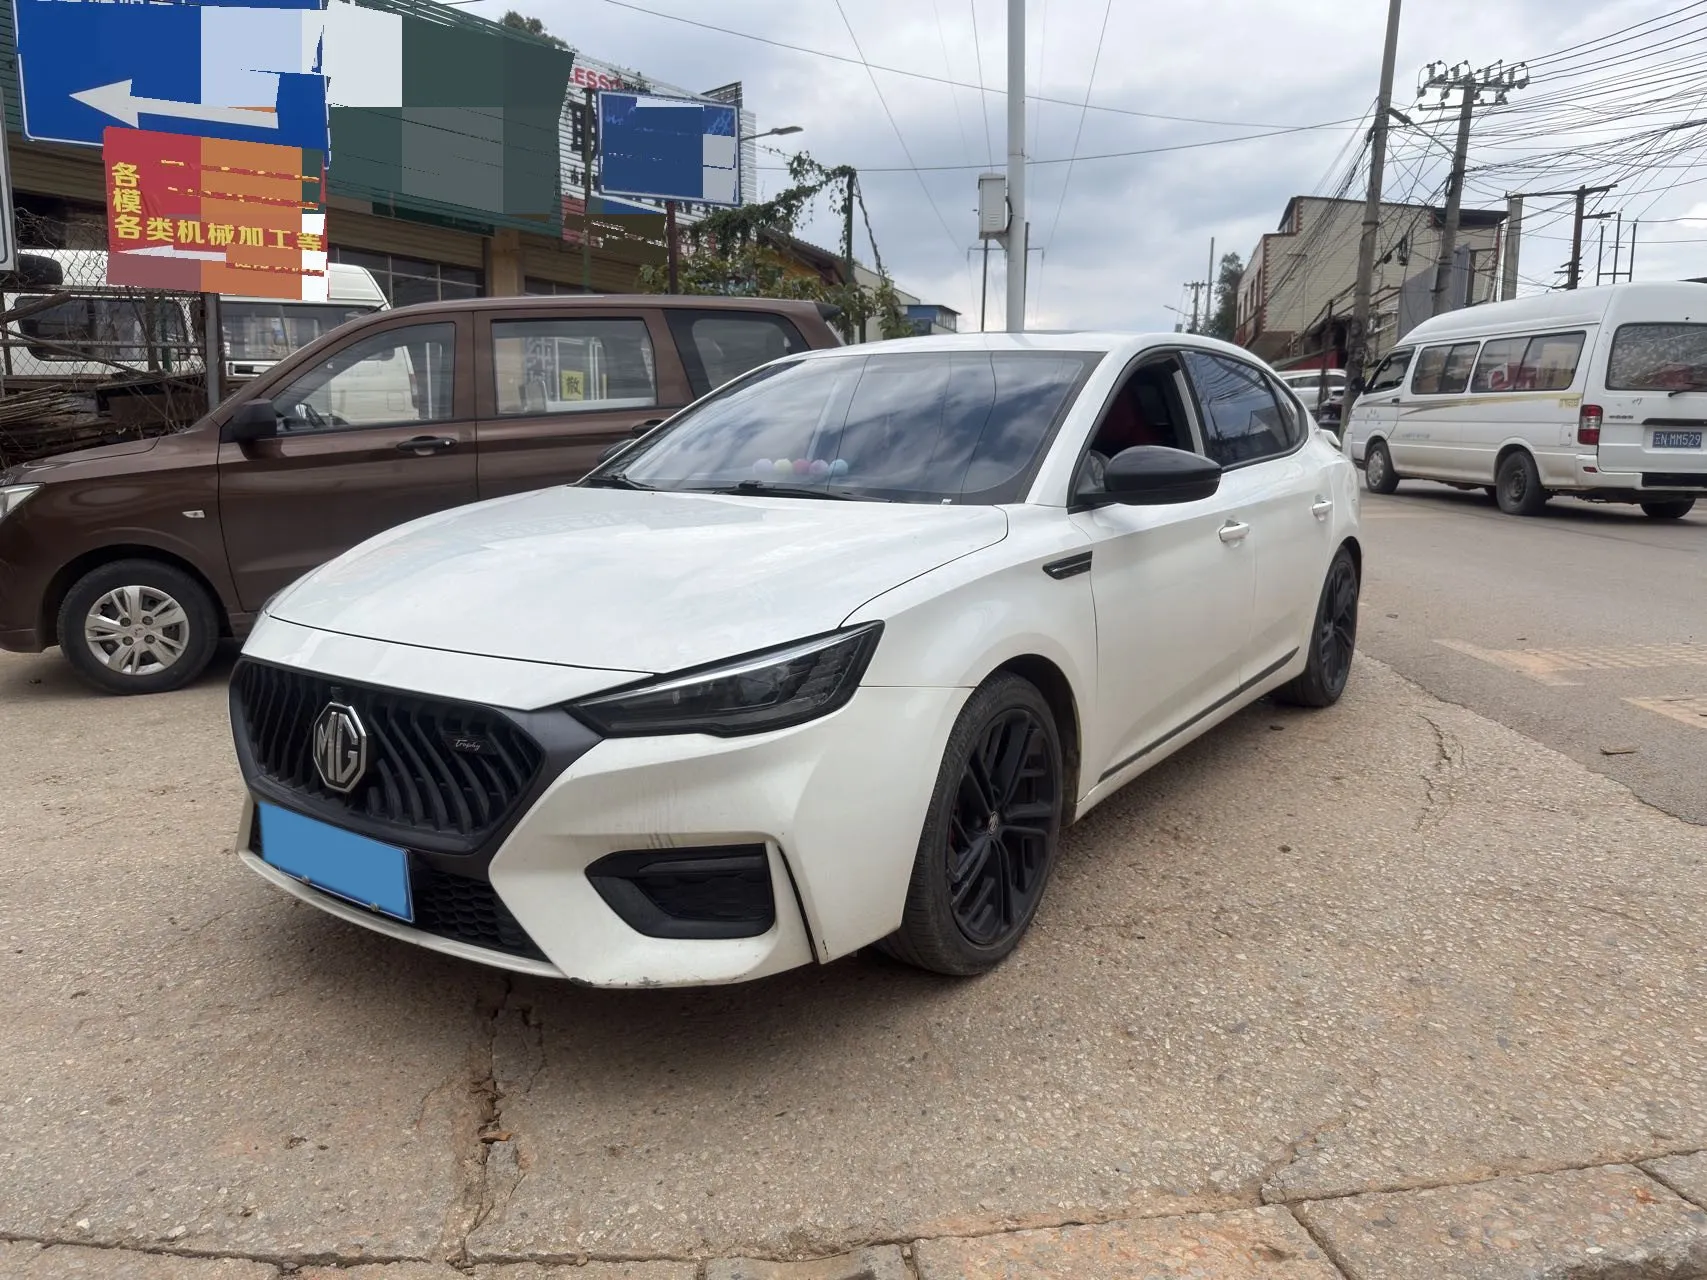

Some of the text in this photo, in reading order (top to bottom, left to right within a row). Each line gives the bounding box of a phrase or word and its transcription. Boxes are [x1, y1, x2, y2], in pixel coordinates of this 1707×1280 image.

[112, 162, 140, 187] 各
[113, 188, 142, 214] 模
[115, 214, 322, 251] 各类机械加工等
[316, 712, 359, 784] MG
[455, 739, 481, 751] Trophy
